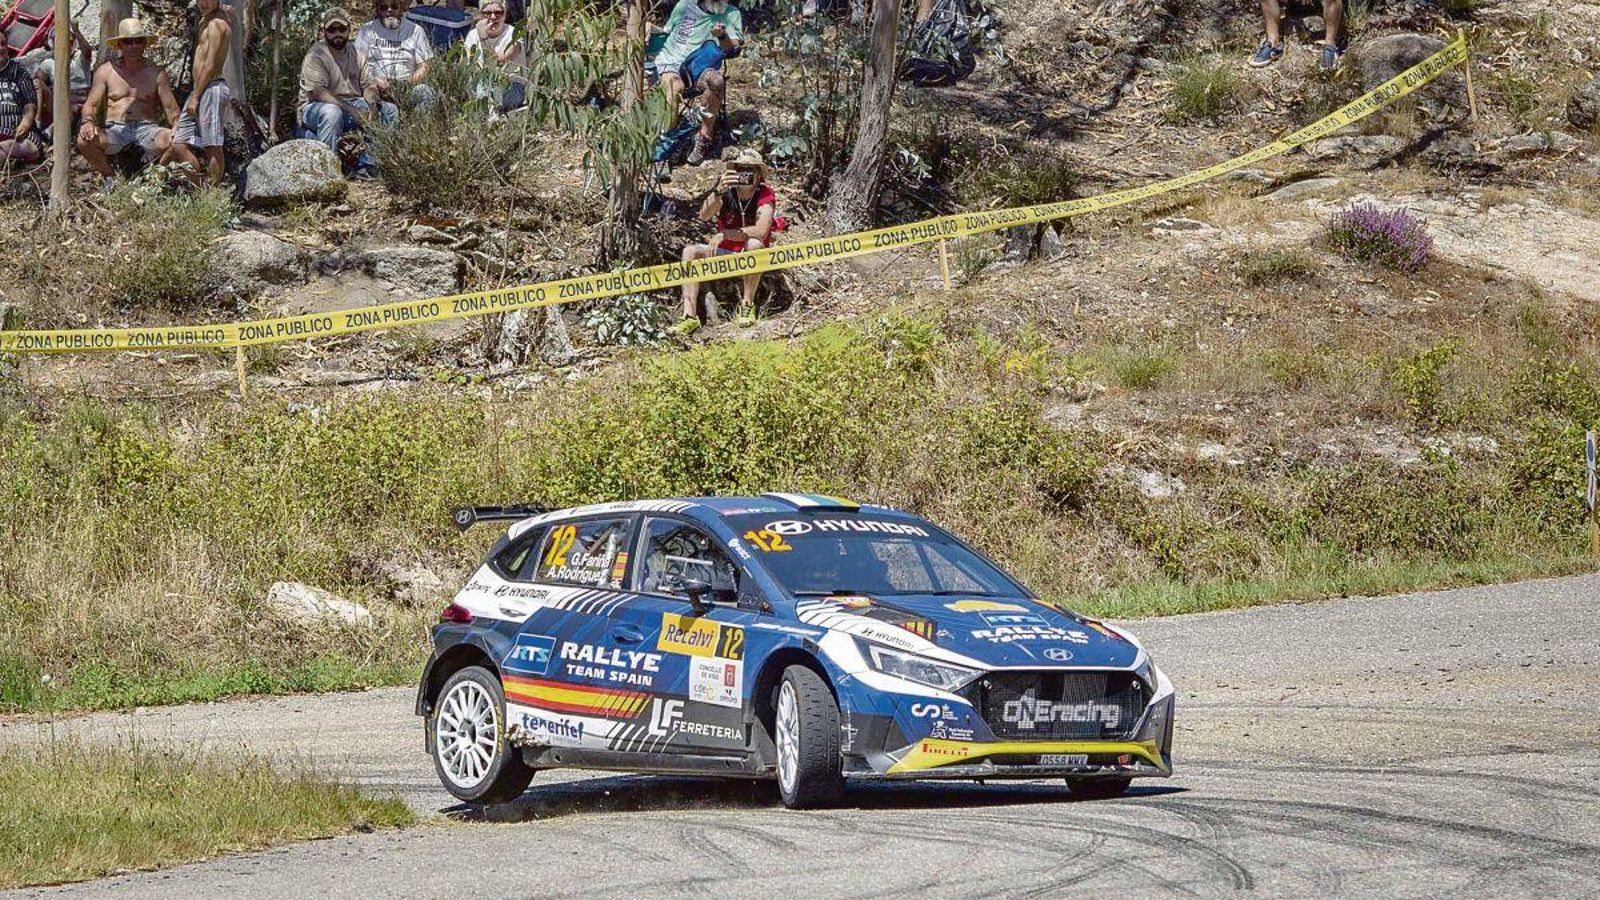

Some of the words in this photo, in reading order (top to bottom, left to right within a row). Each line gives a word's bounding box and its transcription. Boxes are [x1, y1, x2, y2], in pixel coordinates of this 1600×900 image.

[965, 214, 991, 230] ZONA
[990, 209, 1027, 226] PUBLICO
[873, 231, 910, 248] ZONA
[911, 219, 958, 241] PUBLICO
[769, 249, 806, 265] ZONA
[807, 237, 861, 260] PUBLICO
[664, 265, 699, 282] ZONA
[702, 255, 757, 276] PUBLICO
[558, 282, 593, 298] ZONA
[596, 271, 651, 292] PUBLICO
[451, 296, 489, 313] ZONA
[490, 287, 546, 308] PUBLICO
[345, 311, 382, 328] ZONA
[384, 302, 440, 323] PUBLICO
[16, 335, 53, 349] ZONA
[56, 333, 114, 349] PUBLICO
[127, 331, 164, 347] ZONA
[167, 329, 225, 346] PUBLICO
[238, 326, 274, 341] ZONA
[276, 316, 333, 337] PUBLICO
[743, 528, 793, 552] 12
[812, 519, 930, 538] HYUNDAI
[545, 524, 577, 567] 12
[508, 587, 551, 599] HYUNDAI
[666, 622, 714, 649] Recalvi
[723, 628, 743, 659] 12
[971, 626, 1089, 639] RALLYE
[510, 645, 550, 662] RTS
[560, 641, 662, 673] RALLYE
[566, 663, 605, 680] TEAM
[608, 670, 653, 686] SPAIN
[672, 720, 743, 741] FERRETERIA
